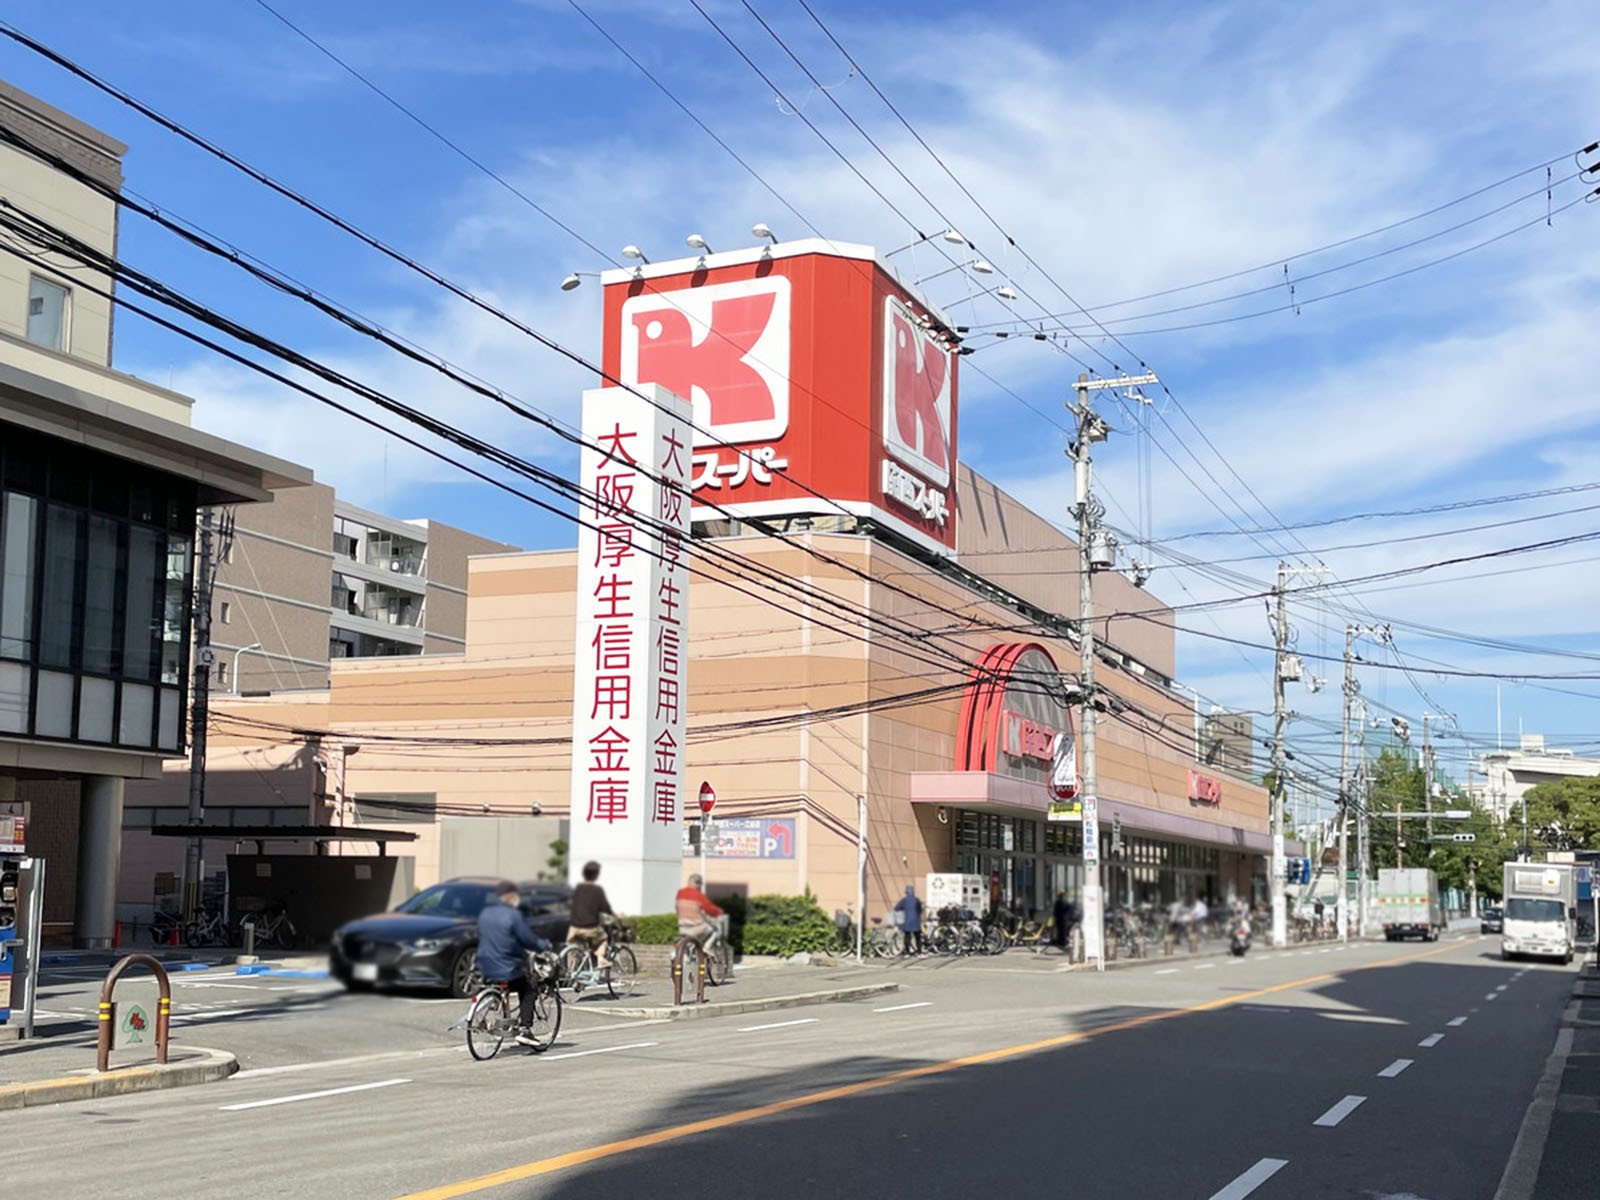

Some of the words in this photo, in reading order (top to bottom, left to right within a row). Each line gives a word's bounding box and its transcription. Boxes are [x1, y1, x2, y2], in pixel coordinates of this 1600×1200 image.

[692, 447, 788, 490] スーパー
[586, 422, 638, 825] 大阪厚生信用金庫
[652, 427, 685, 827] 大阪厚生信用金庫
[764, 837, 778, 857] P
